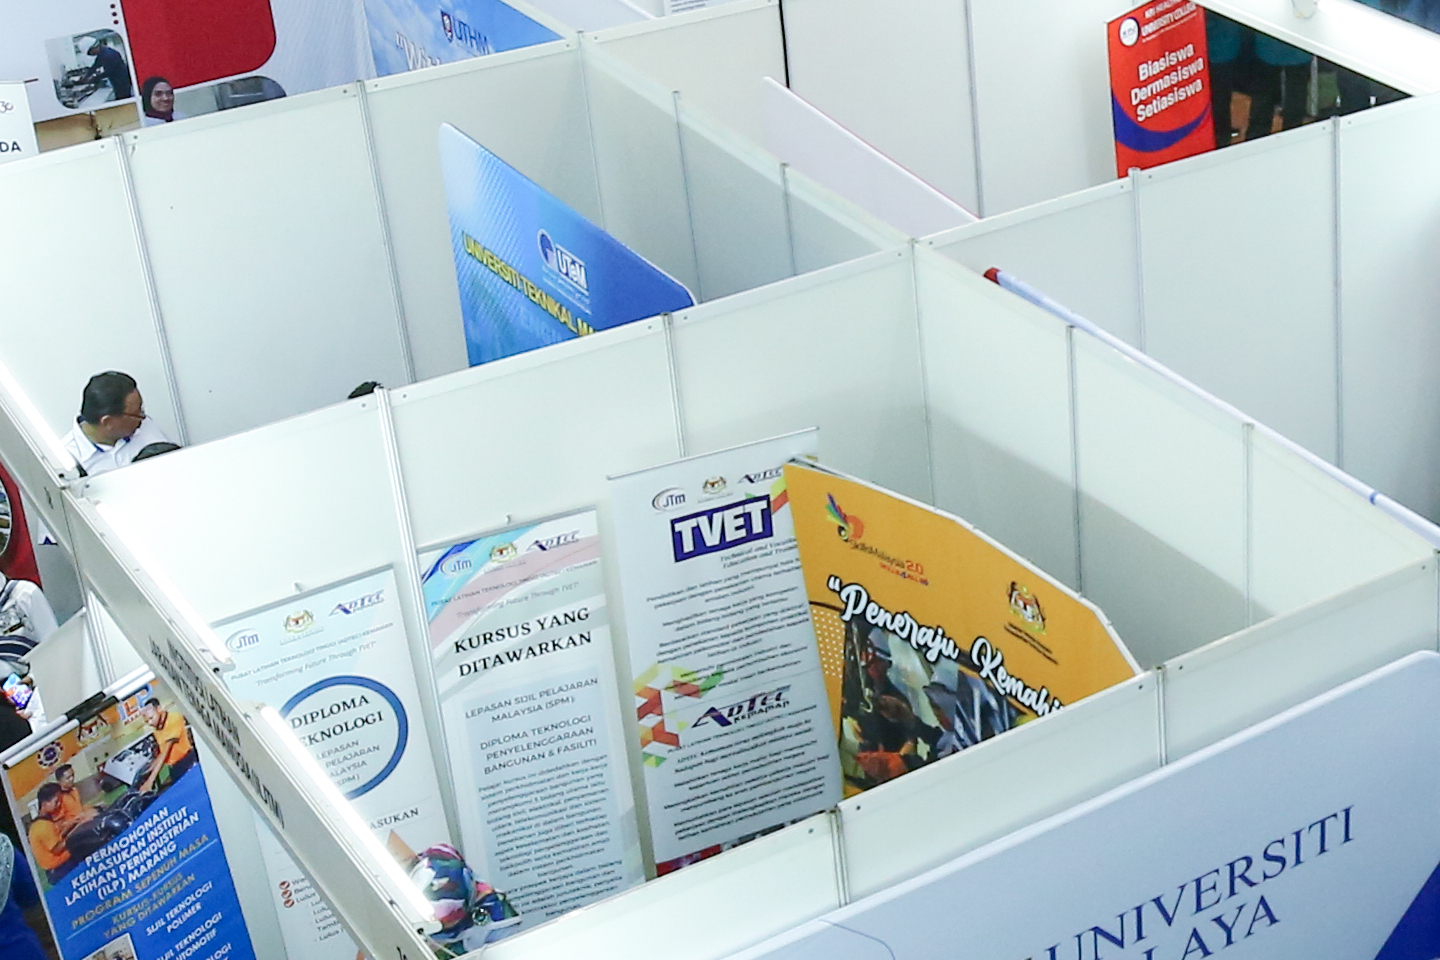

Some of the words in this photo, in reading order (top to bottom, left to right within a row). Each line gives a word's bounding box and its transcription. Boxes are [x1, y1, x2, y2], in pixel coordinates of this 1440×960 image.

[452, 11, 489, 54] UTHM
[1130, 57, 1205, 106] Dermasiswa
[1138, 43, 1195, 82] Biasiswa
[1136, 78, 1203, 123] Setiasiswa
[462, 230, 521, 292] UNIVERSITI
[518, 275, 579, 335] TEKNIKAL
[557, 248, 589, 290] UTeM
[675, 499, 771, 553] TVET
[454, 621, 532, 654] KURSUS
[536, 607, 591, 632] YANG
[458, 631, 593, 679] DITAWARKAN
[290, 694, 370, 730] DIPLOMA
[464, 699, 512, 719] LEPASAN
[539, 678, 599, 702] PELAJARAN
[490, 704, 544, 723] MALAYSIA
[479, 730, 528, 751] DIPLOMA
[529, 714, 592, 739] TEKNOLOGI
[485, 726, 595, 762] PENYELENGGARAAN
[483, 750, 544, 776] BANGUNAN
[546, 747, 556, 759] &
[556, 738, 598, 758] FASILITI
[64, 869, 118, 907] LATIHAN
[119, 811, 201, 876] PERINDUSTRIAN
[70, 838, 147, 890] KEMASUKAN
[146, 805, 189, 845] INSTITUT
[84, 806, 169, 867] PERMOHONAN
[71, 890, 134, 930] PROGRAM
[134, 855, 179, 892] SEPENUH
[177, 833, 210, 860] MASA
[97, 879, 126, 901] (ILP)
[127, 841, 178, 884] MARANG
[145, 913, 168, 937] SIJIL
[165, 880, 214, 923] TEKNOLOGI
[166, 901, 203, 934] POLIMER
